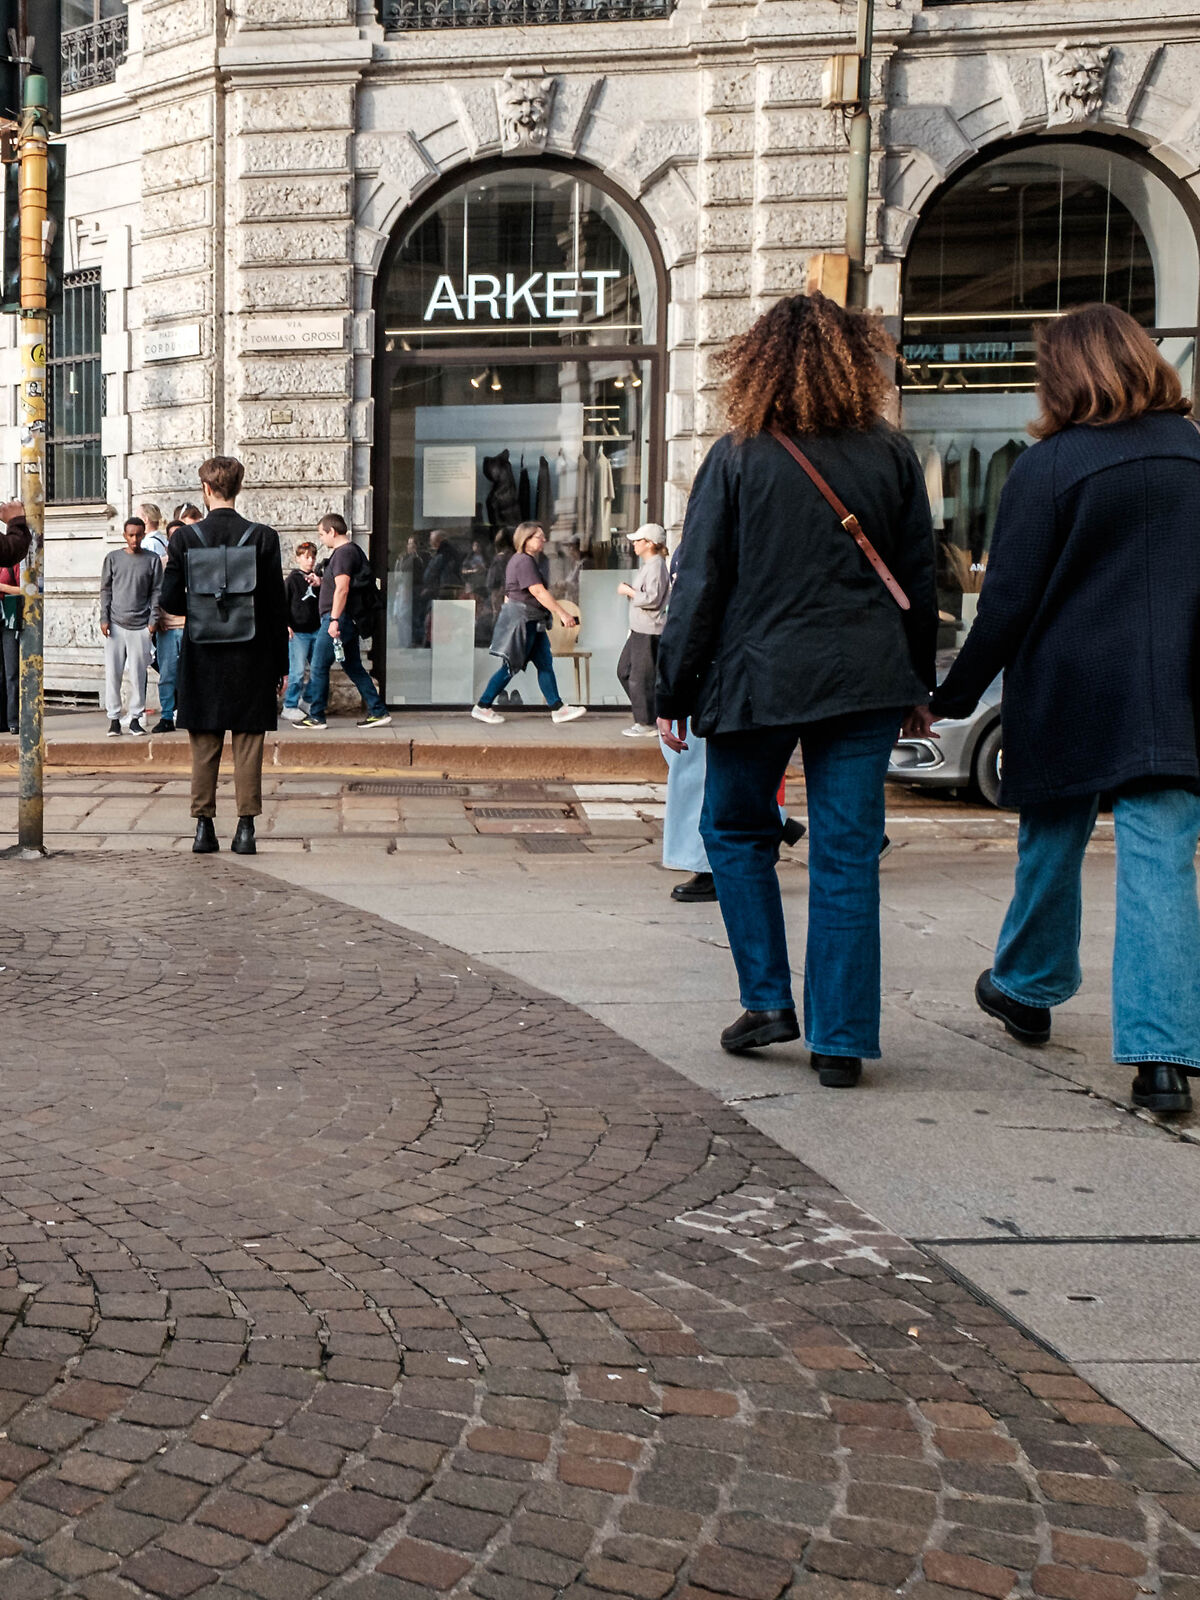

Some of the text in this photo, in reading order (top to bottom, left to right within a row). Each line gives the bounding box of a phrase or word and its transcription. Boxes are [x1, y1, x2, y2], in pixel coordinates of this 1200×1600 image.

[423, 269, 621, 322] ARKET
[250, 331, 341, 344] TOMMASO GROSSI
